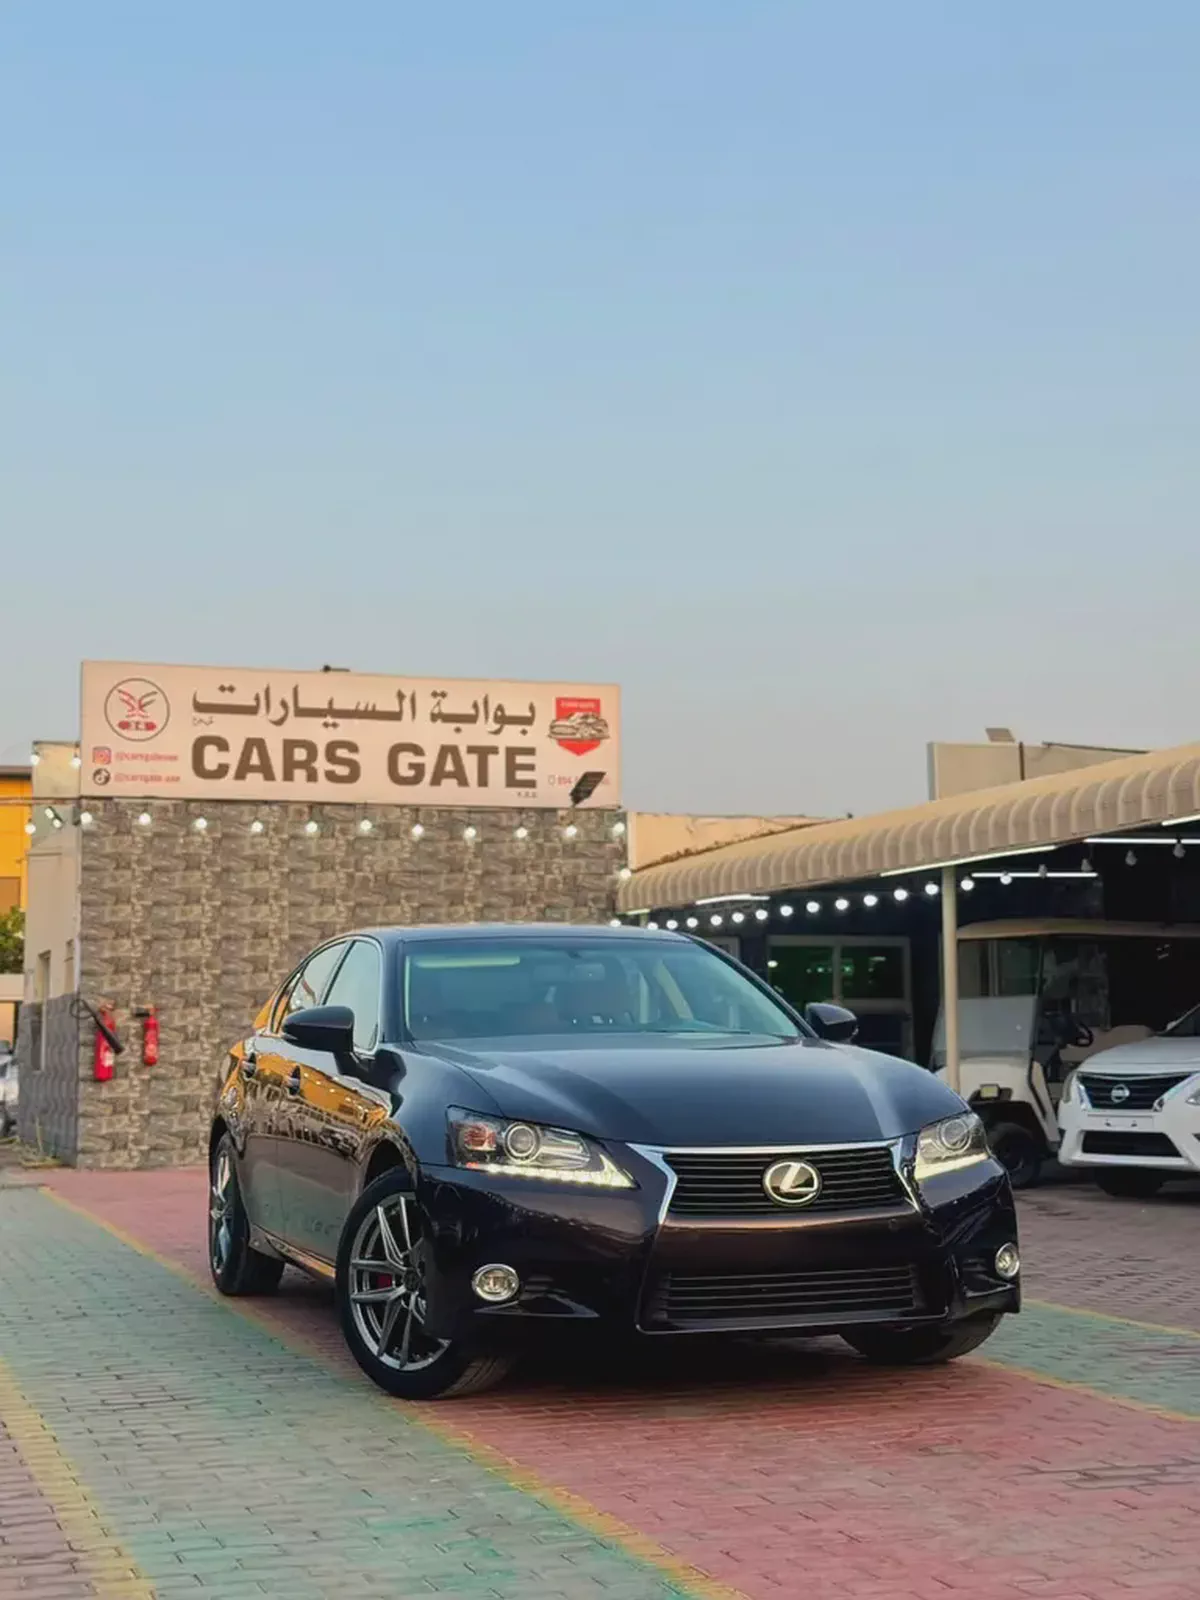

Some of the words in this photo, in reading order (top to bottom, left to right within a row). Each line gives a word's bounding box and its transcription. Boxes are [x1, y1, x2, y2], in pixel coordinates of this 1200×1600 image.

[192, 684, 417, 730] السيارات
[430, 689, 536, 736] بوابة
[191, 735, 361, 784] CARS
[387, 742, 537, 789] GATE
